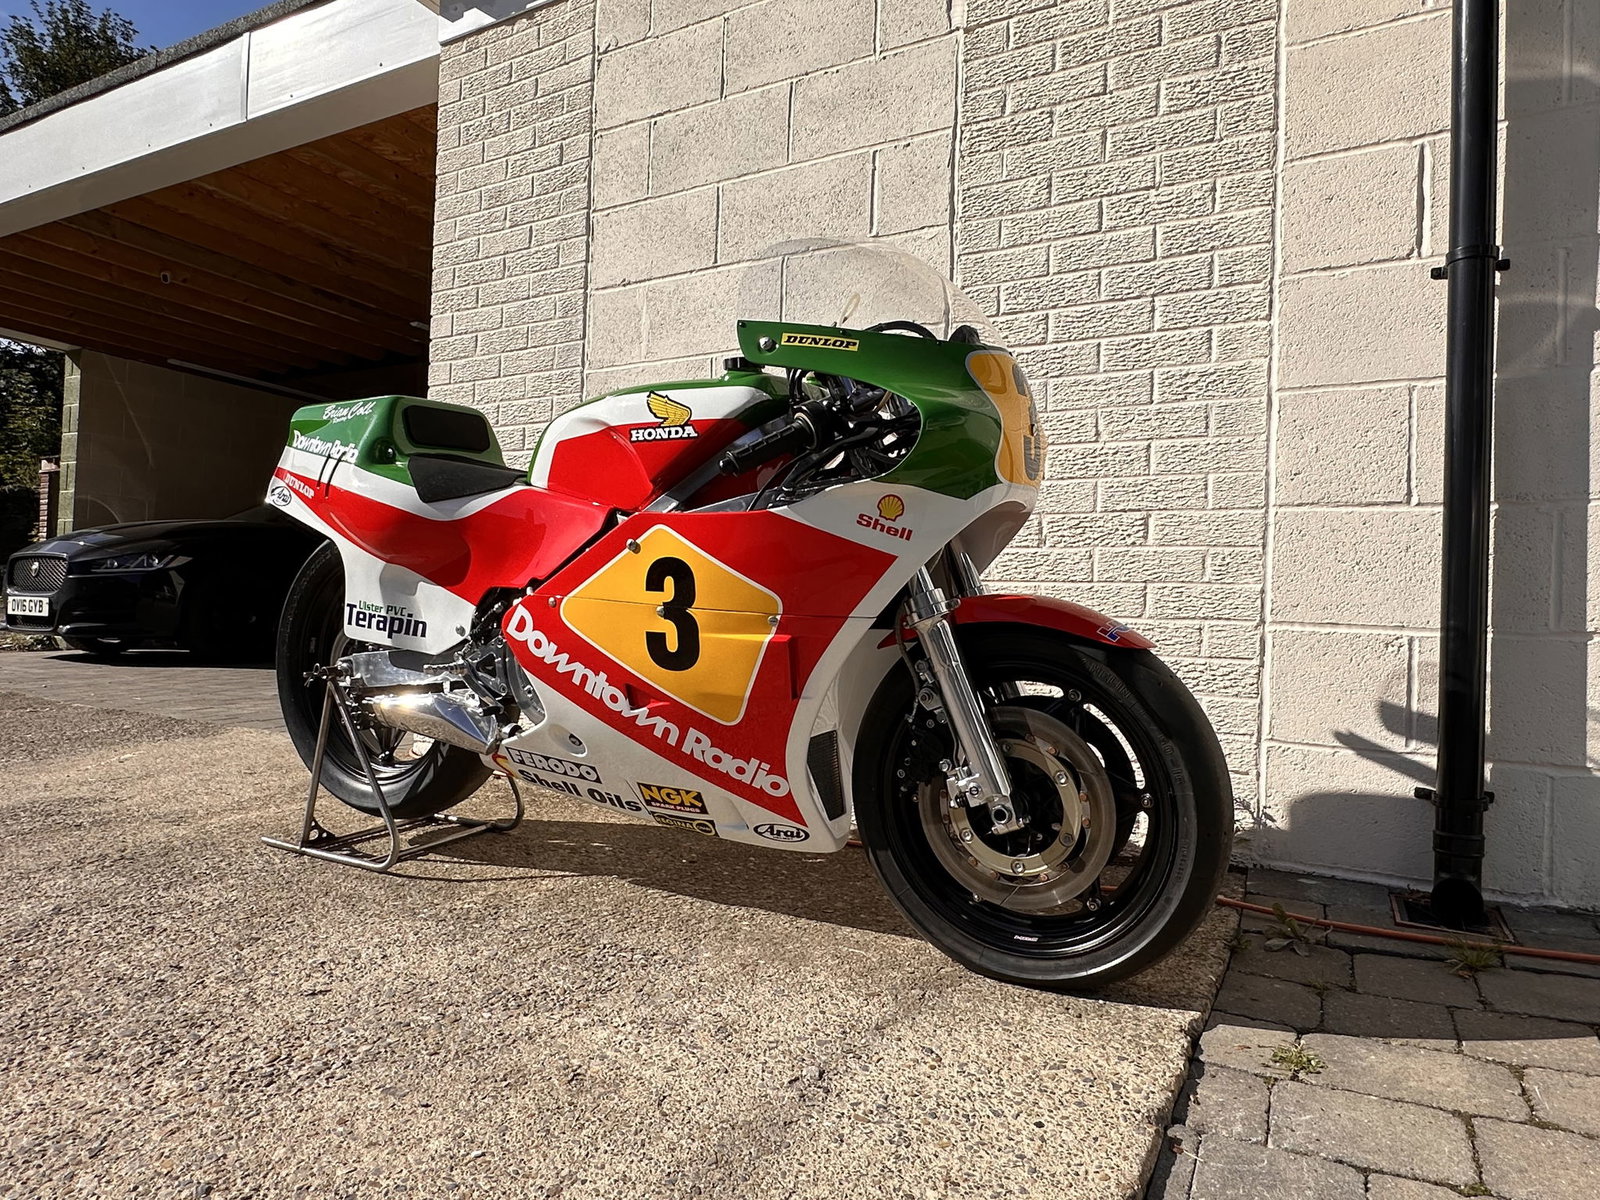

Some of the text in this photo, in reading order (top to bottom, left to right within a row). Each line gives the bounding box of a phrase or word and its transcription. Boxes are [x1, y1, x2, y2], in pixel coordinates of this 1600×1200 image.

[784, 335, 858, 349] DUNLOP
[322, 401, 377, 420] Brian Coll
[292, 429, 333, 456] Downtown
[630, 425, 698, 441] HONDA
[285, 472, 315, 499] DUNLOP
[856, 513, 913, 541] Shell
[28, 599, 43, 613] GYB
[386, 605, 407, 617] PVC
[645, 556, 701, 672] 3
[346, 603, 428, 639] Terapin
[506, 604, 790, 798] Downtown Radio
[509, 748, 598, 781] FERODO
[518, 769, 642, 812] Shell Oils
[640, 785, 703, 807] NGK
[650, 801, 701, 813] SPARK PLUGS
[757, 824, 804, 838] Arai
